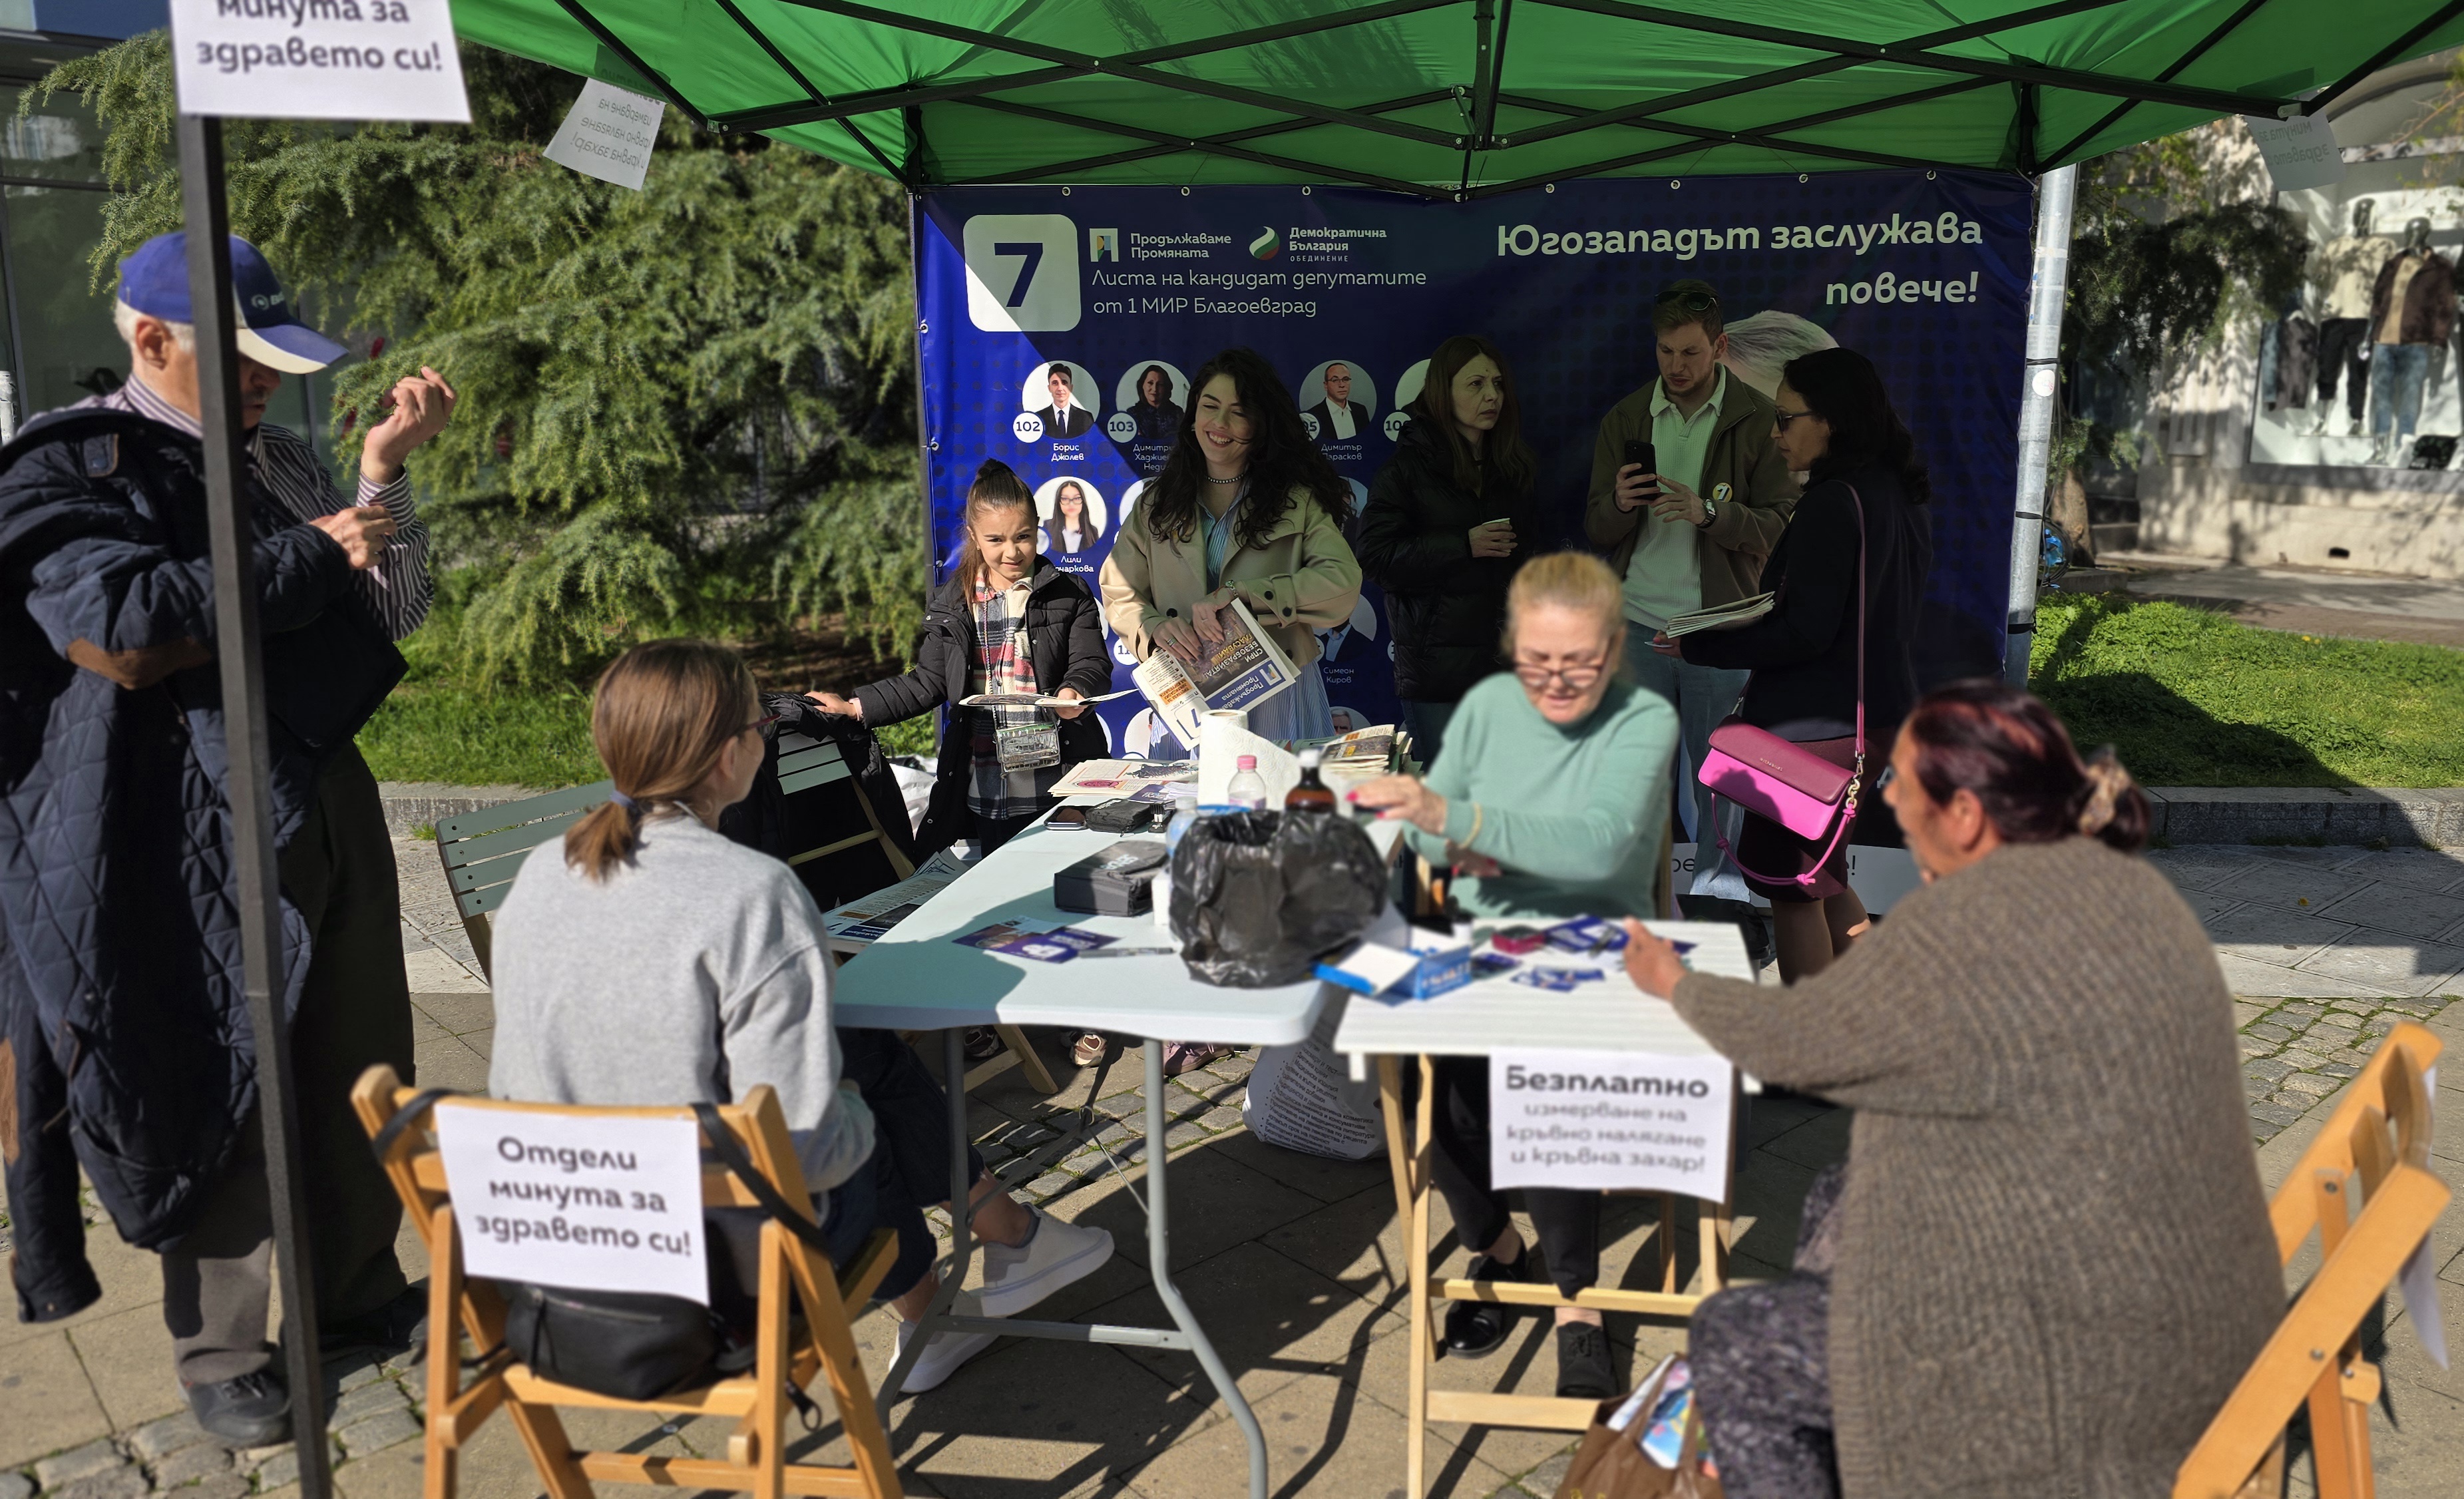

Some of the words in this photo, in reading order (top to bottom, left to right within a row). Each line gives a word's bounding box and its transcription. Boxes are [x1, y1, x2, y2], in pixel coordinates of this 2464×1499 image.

[218, 0, 363, 27] минута
[371, 1, 409, 23] за
[197, 35, 385, 73] здравето
[394, 42, 443, 71] си!
[1131, 233, 1231, 246] Продължаваме
[1289, 227, 1386, 239] Демократична
[1498, 224, 1759, 260] Югозападът
[1771, 212, 1982, 256] заслужава
[1131, 248, 1209, 260] Промяната
[1289, 241, 1348, 252] България
[994, 242, 1044, 308] 7
[1092, 270, 1155, 286] Листа
[1162, 273, 1184, 286] на
[1189, 270, 1286, 290] кандидат
[1293, 272, 1426, 290] депутатите
[1826, 272, 1978, 304] повече!
[1094, 302, 1123, 314] от
[1128, 298, 1137, 314] 1
[1143, 298, 1188, 314] МИР
[1194, 297, 1316, 318] Благоевград
[1016, 421, 1040, 432] 102
[1110, 421, 1134, 432] 103
[1053, 443, 1080, 453] Борис
[1321, 443, 1362, 452] Димитър
[1203, 640, 1259, 679] БЕЗОБРАЗИЯТА!
[1245, 648, 1263, 663] СПРИ
[1221, 676, 1259, 701] Промяната
[1326, 676, 1352, 684] Киров
[1506, 1065, 1709, 1098] Безплатно
[1524, 1102, 1653, 1120] измерване
[1658, 1109, 1687, 1122] на
[1507, 1125, 1591, 1143] кръвно
[1597, 1131, 1706, 1148] налягане
[498, 1136, 637, 1174] Отдели
[1511, 1152, 1526, 1164] и
[1532, 1147, 1621, 1167] кръвна
[1628, 1156, 1705, 1174] захар!
[489, 1180, 623, 1209] минута
[632, 1192, 666, 1213] за
[475, 1216, 640, 1249] здравето
[648, 1231, 692, 1257] си!
